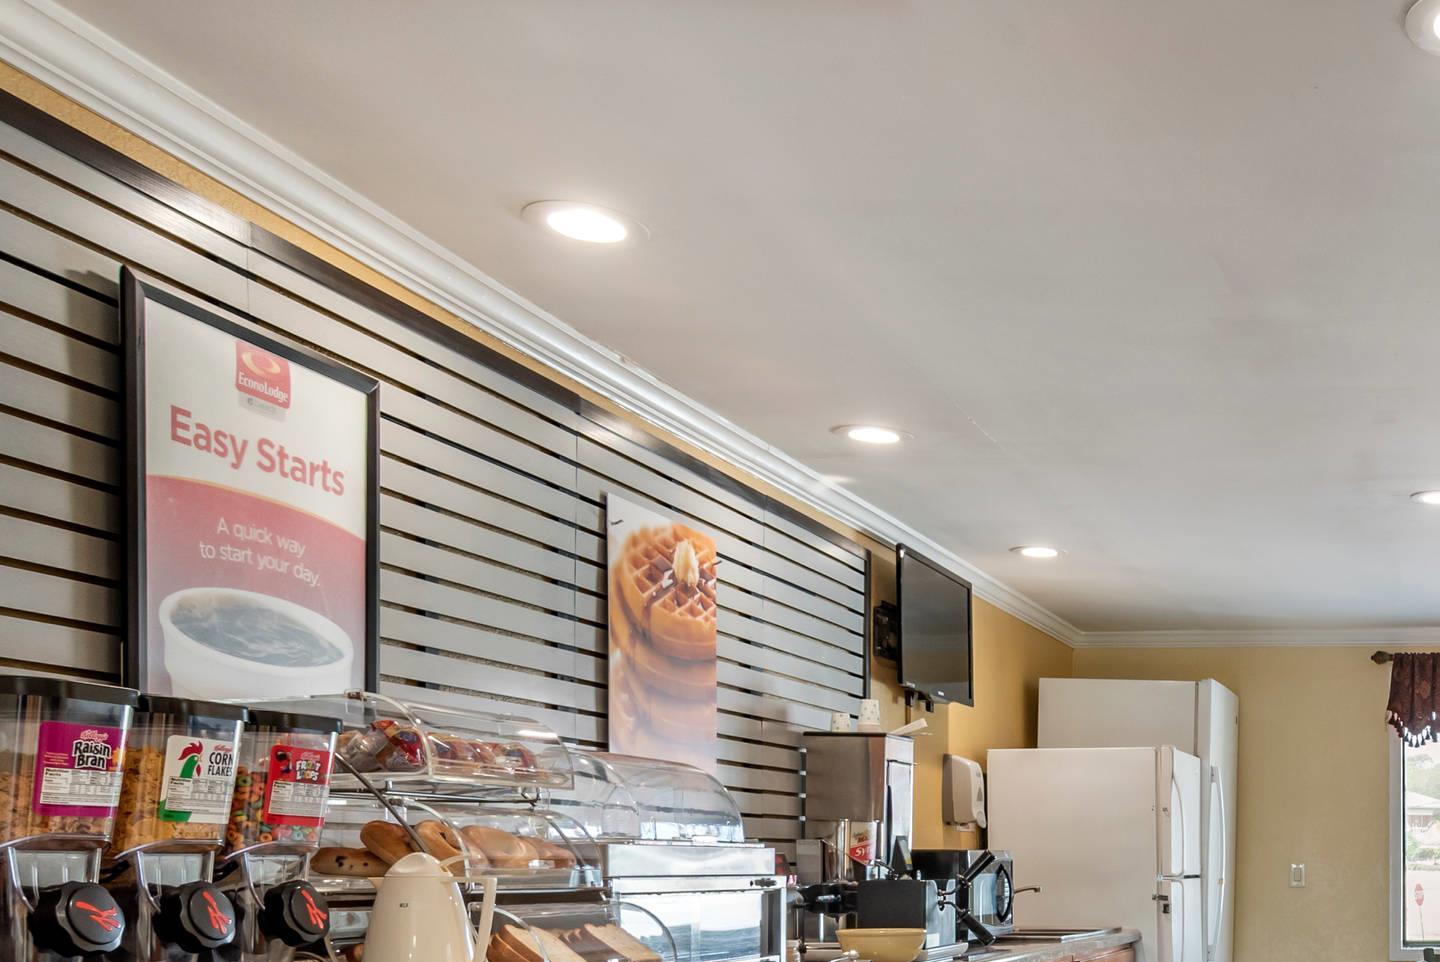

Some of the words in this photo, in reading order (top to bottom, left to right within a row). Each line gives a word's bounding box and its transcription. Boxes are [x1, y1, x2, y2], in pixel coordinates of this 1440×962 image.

[170, 404, 248, 470] Easy
[256, 437, 345, 496] Starts
[216, 517, 229, 535] A
[233, 523, 273, 545] quick
[277, 534, 306, 558] way
[200, 541, 216, 559] to
[220, 543, 253, 564] start
[257, 554, 290, 575] your
[292, 562, 321, 587] day.
[72, 740, 111, 759] Raisin
[75, 754, 107, 770] Bran
